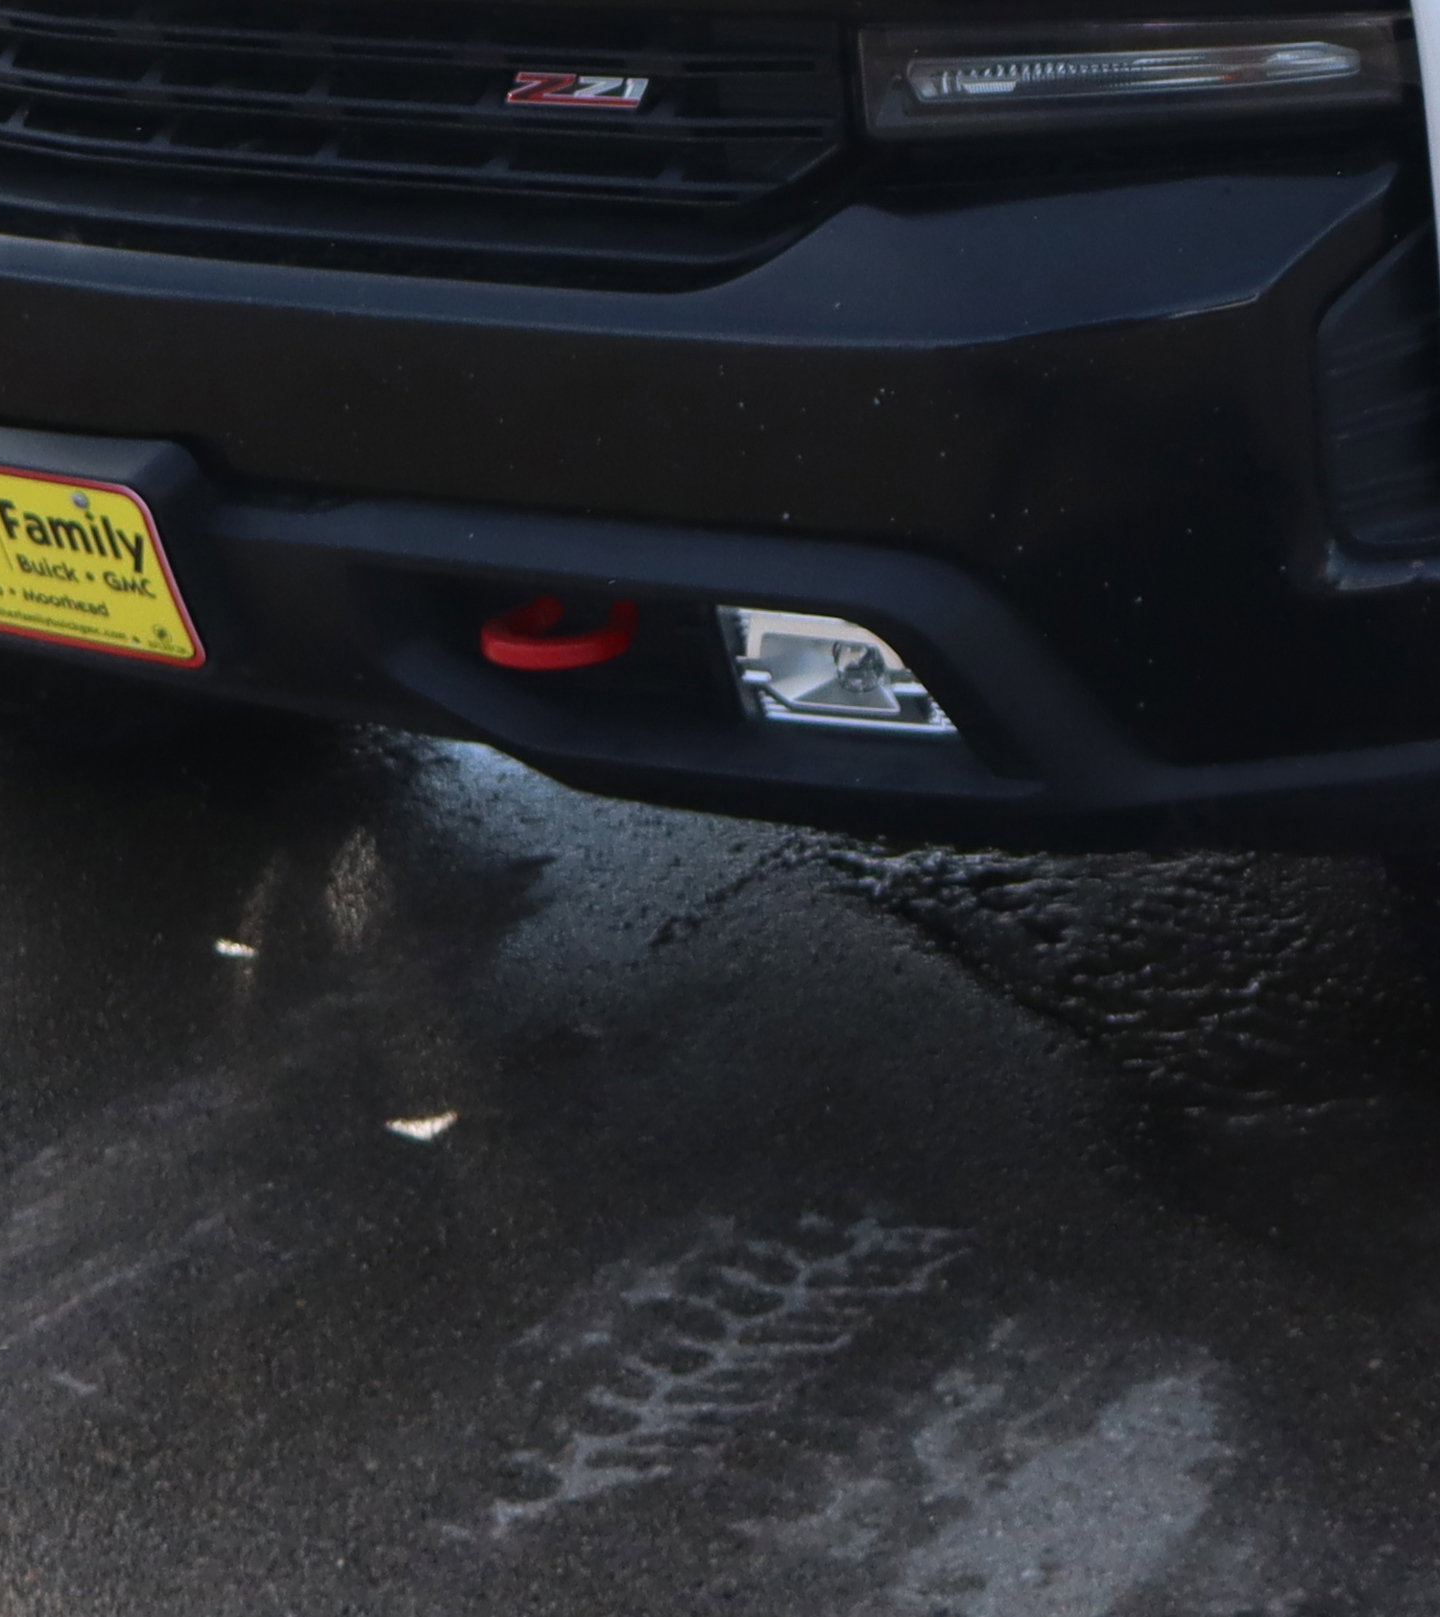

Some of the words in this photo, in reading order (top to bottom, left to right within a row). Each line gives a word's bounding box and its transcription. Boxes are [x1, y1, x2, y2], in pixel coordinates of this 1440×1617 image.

[505, 71, 650, 109] Z71
[16, 553, 77, 583] Buick
[102, 570, 157, 599] GMC
[22, 587, 110, 617] Moorhead
